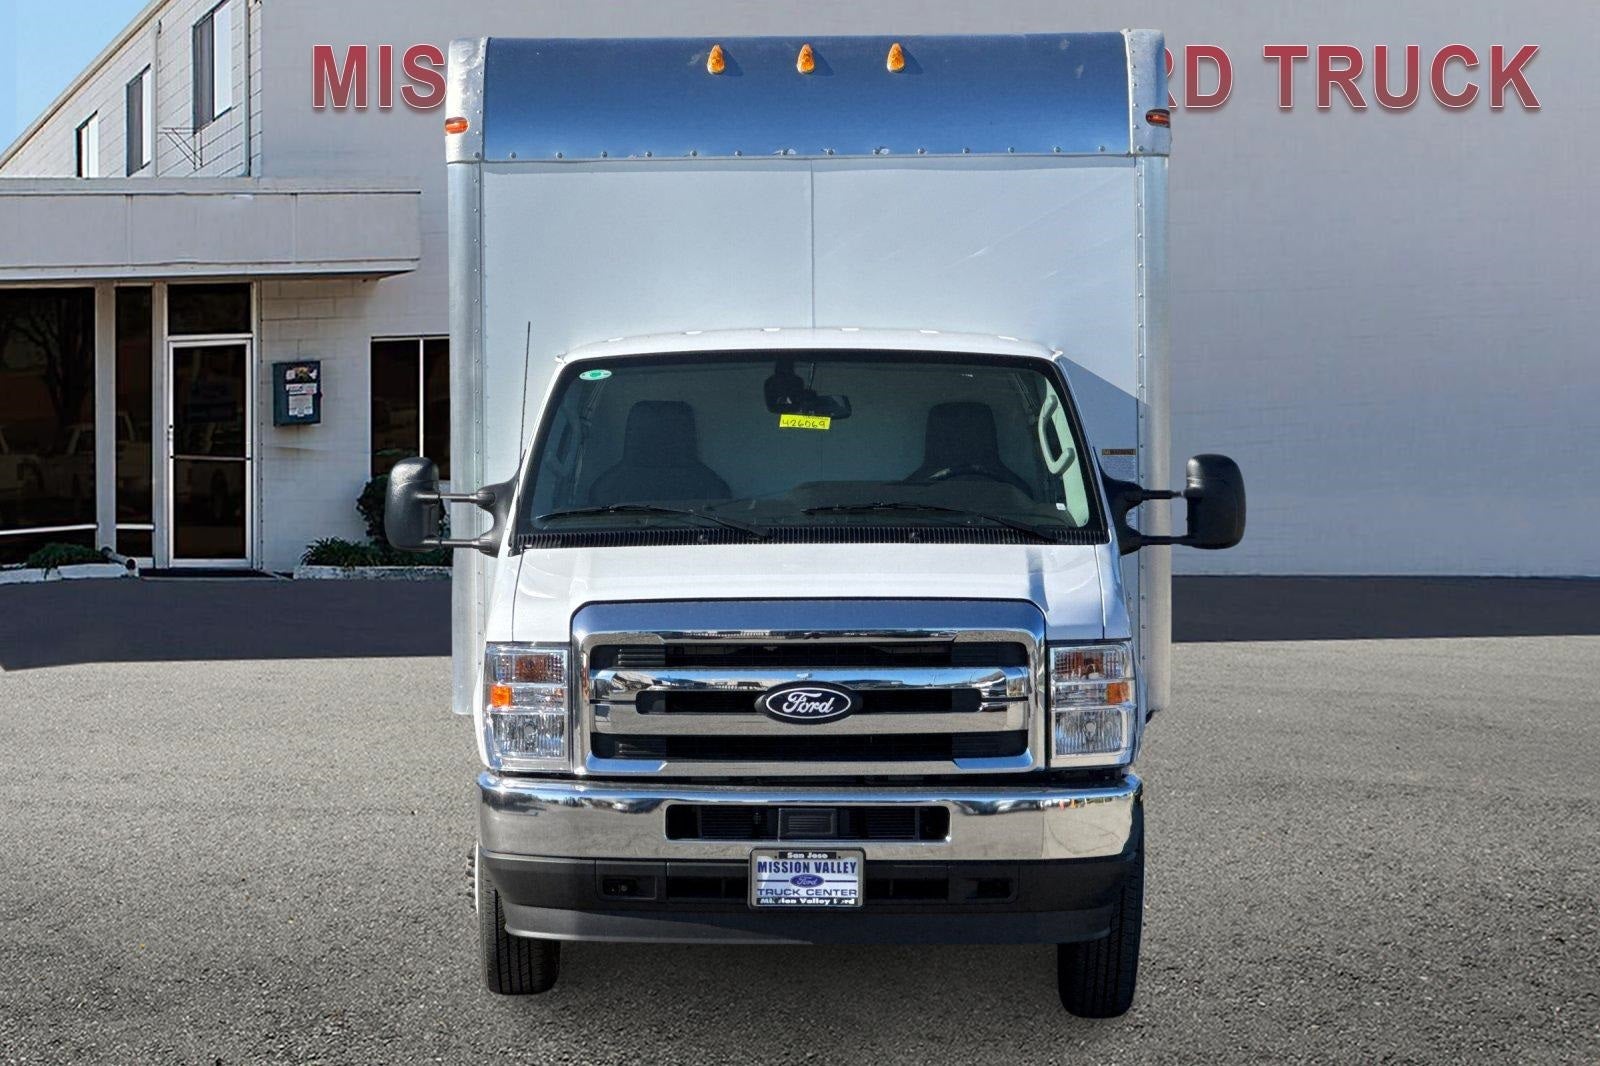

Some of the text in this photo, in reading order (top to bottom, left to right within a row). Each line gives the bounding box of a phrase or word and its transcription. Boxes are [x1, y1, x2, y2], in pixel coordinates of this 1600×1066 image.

[1262, 43, 1542, 109] TRUCK
[782, 418, 827, 429] 426069
[782, 691, 835, 714] Ford
[757, 861, 857, 874] MISSION VALLEY
[796, 876, 818, 886] Ford
[757, 888, 858, 896] TRUCK CENTER
[800, 898, 831, 906] Valley
